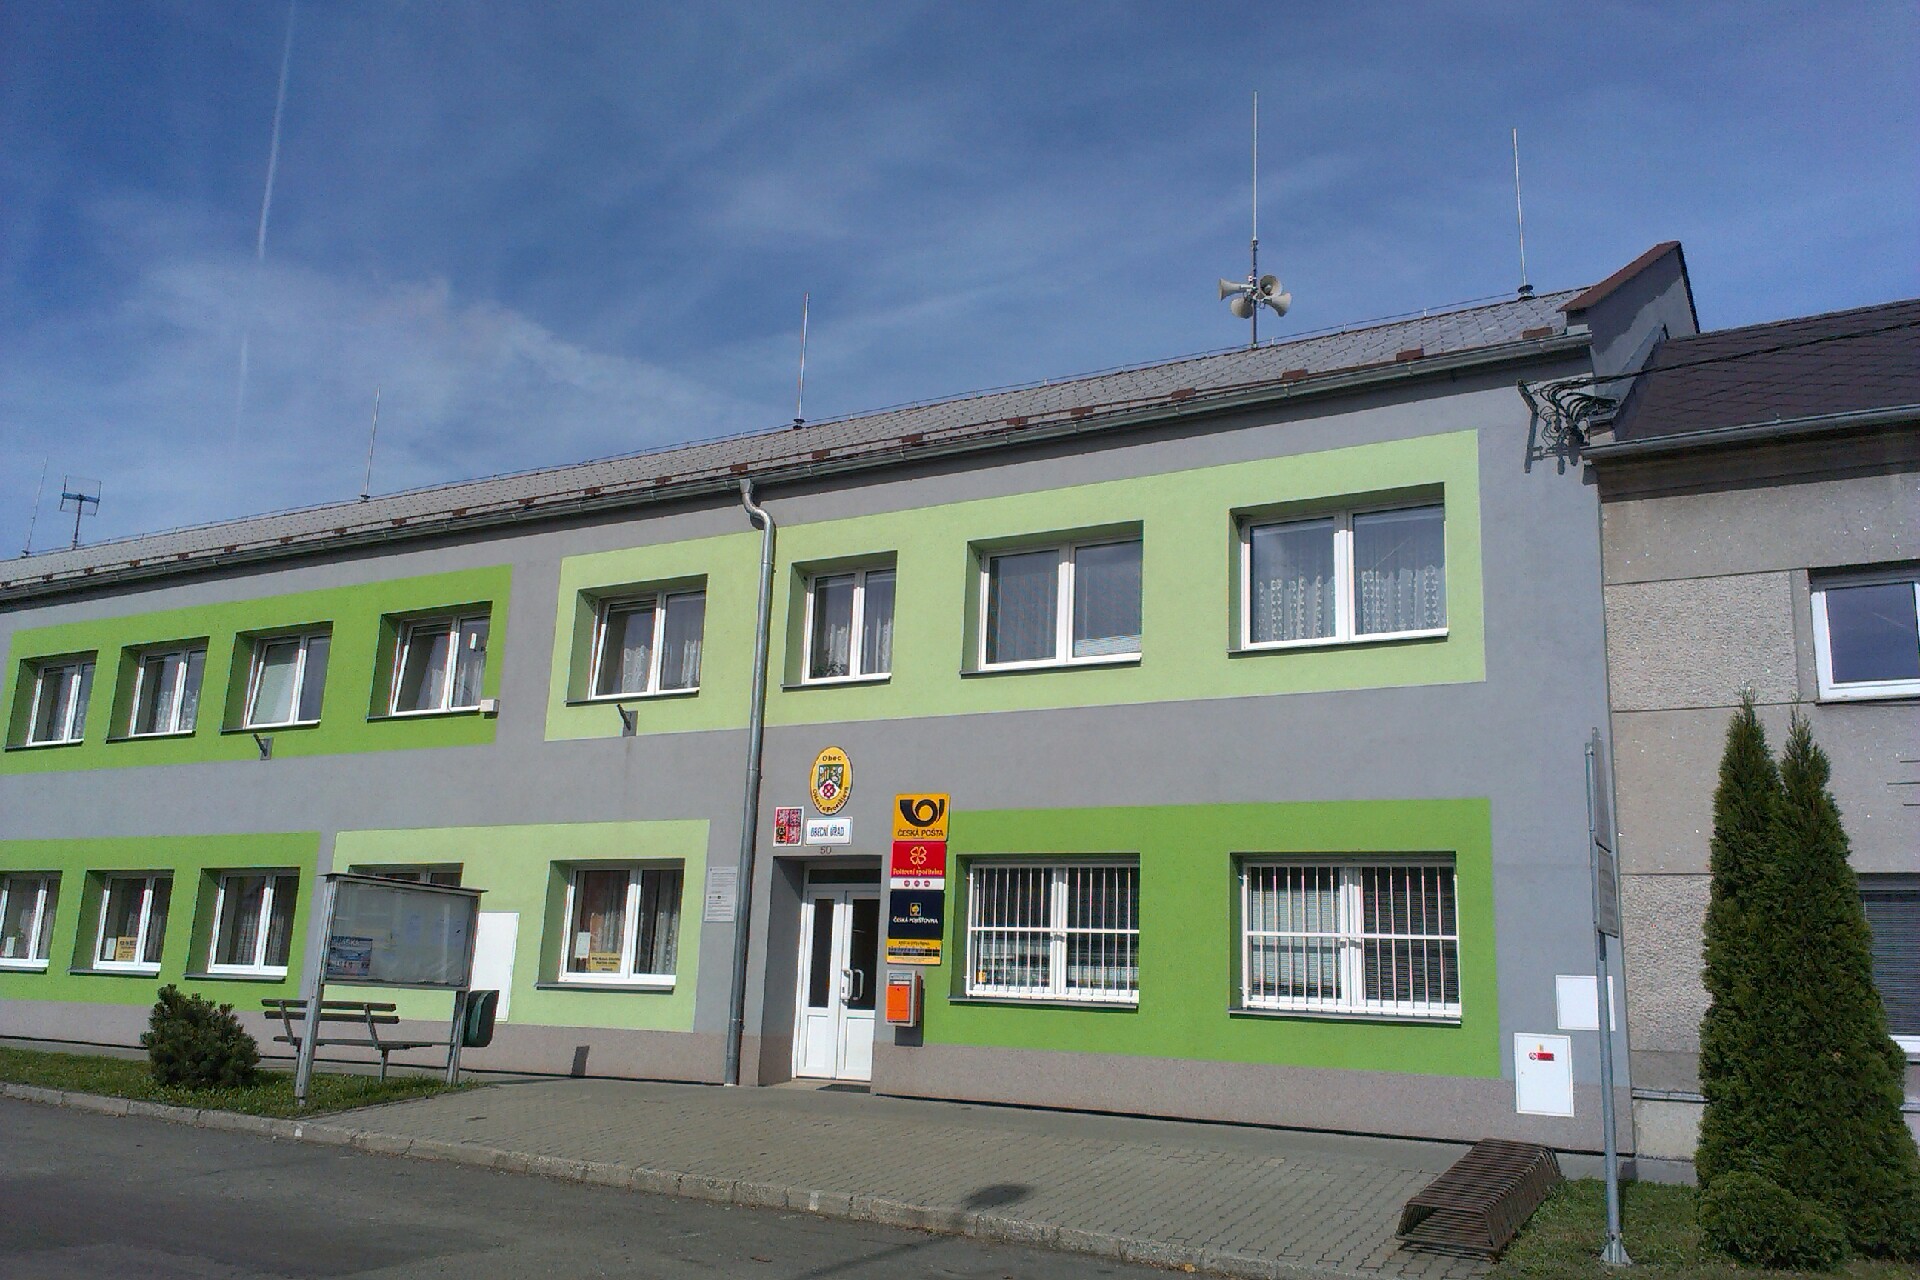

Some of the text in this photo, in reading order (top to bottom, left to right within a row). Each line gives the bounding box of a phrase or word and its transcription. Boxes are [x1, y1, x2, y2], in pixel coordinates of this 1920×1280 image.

[897, 828, 944, 837] ČESKÁ POŠTA
[820, 845, 832, 855] 50
[892, 915, 908, 923] ČESKÁ
